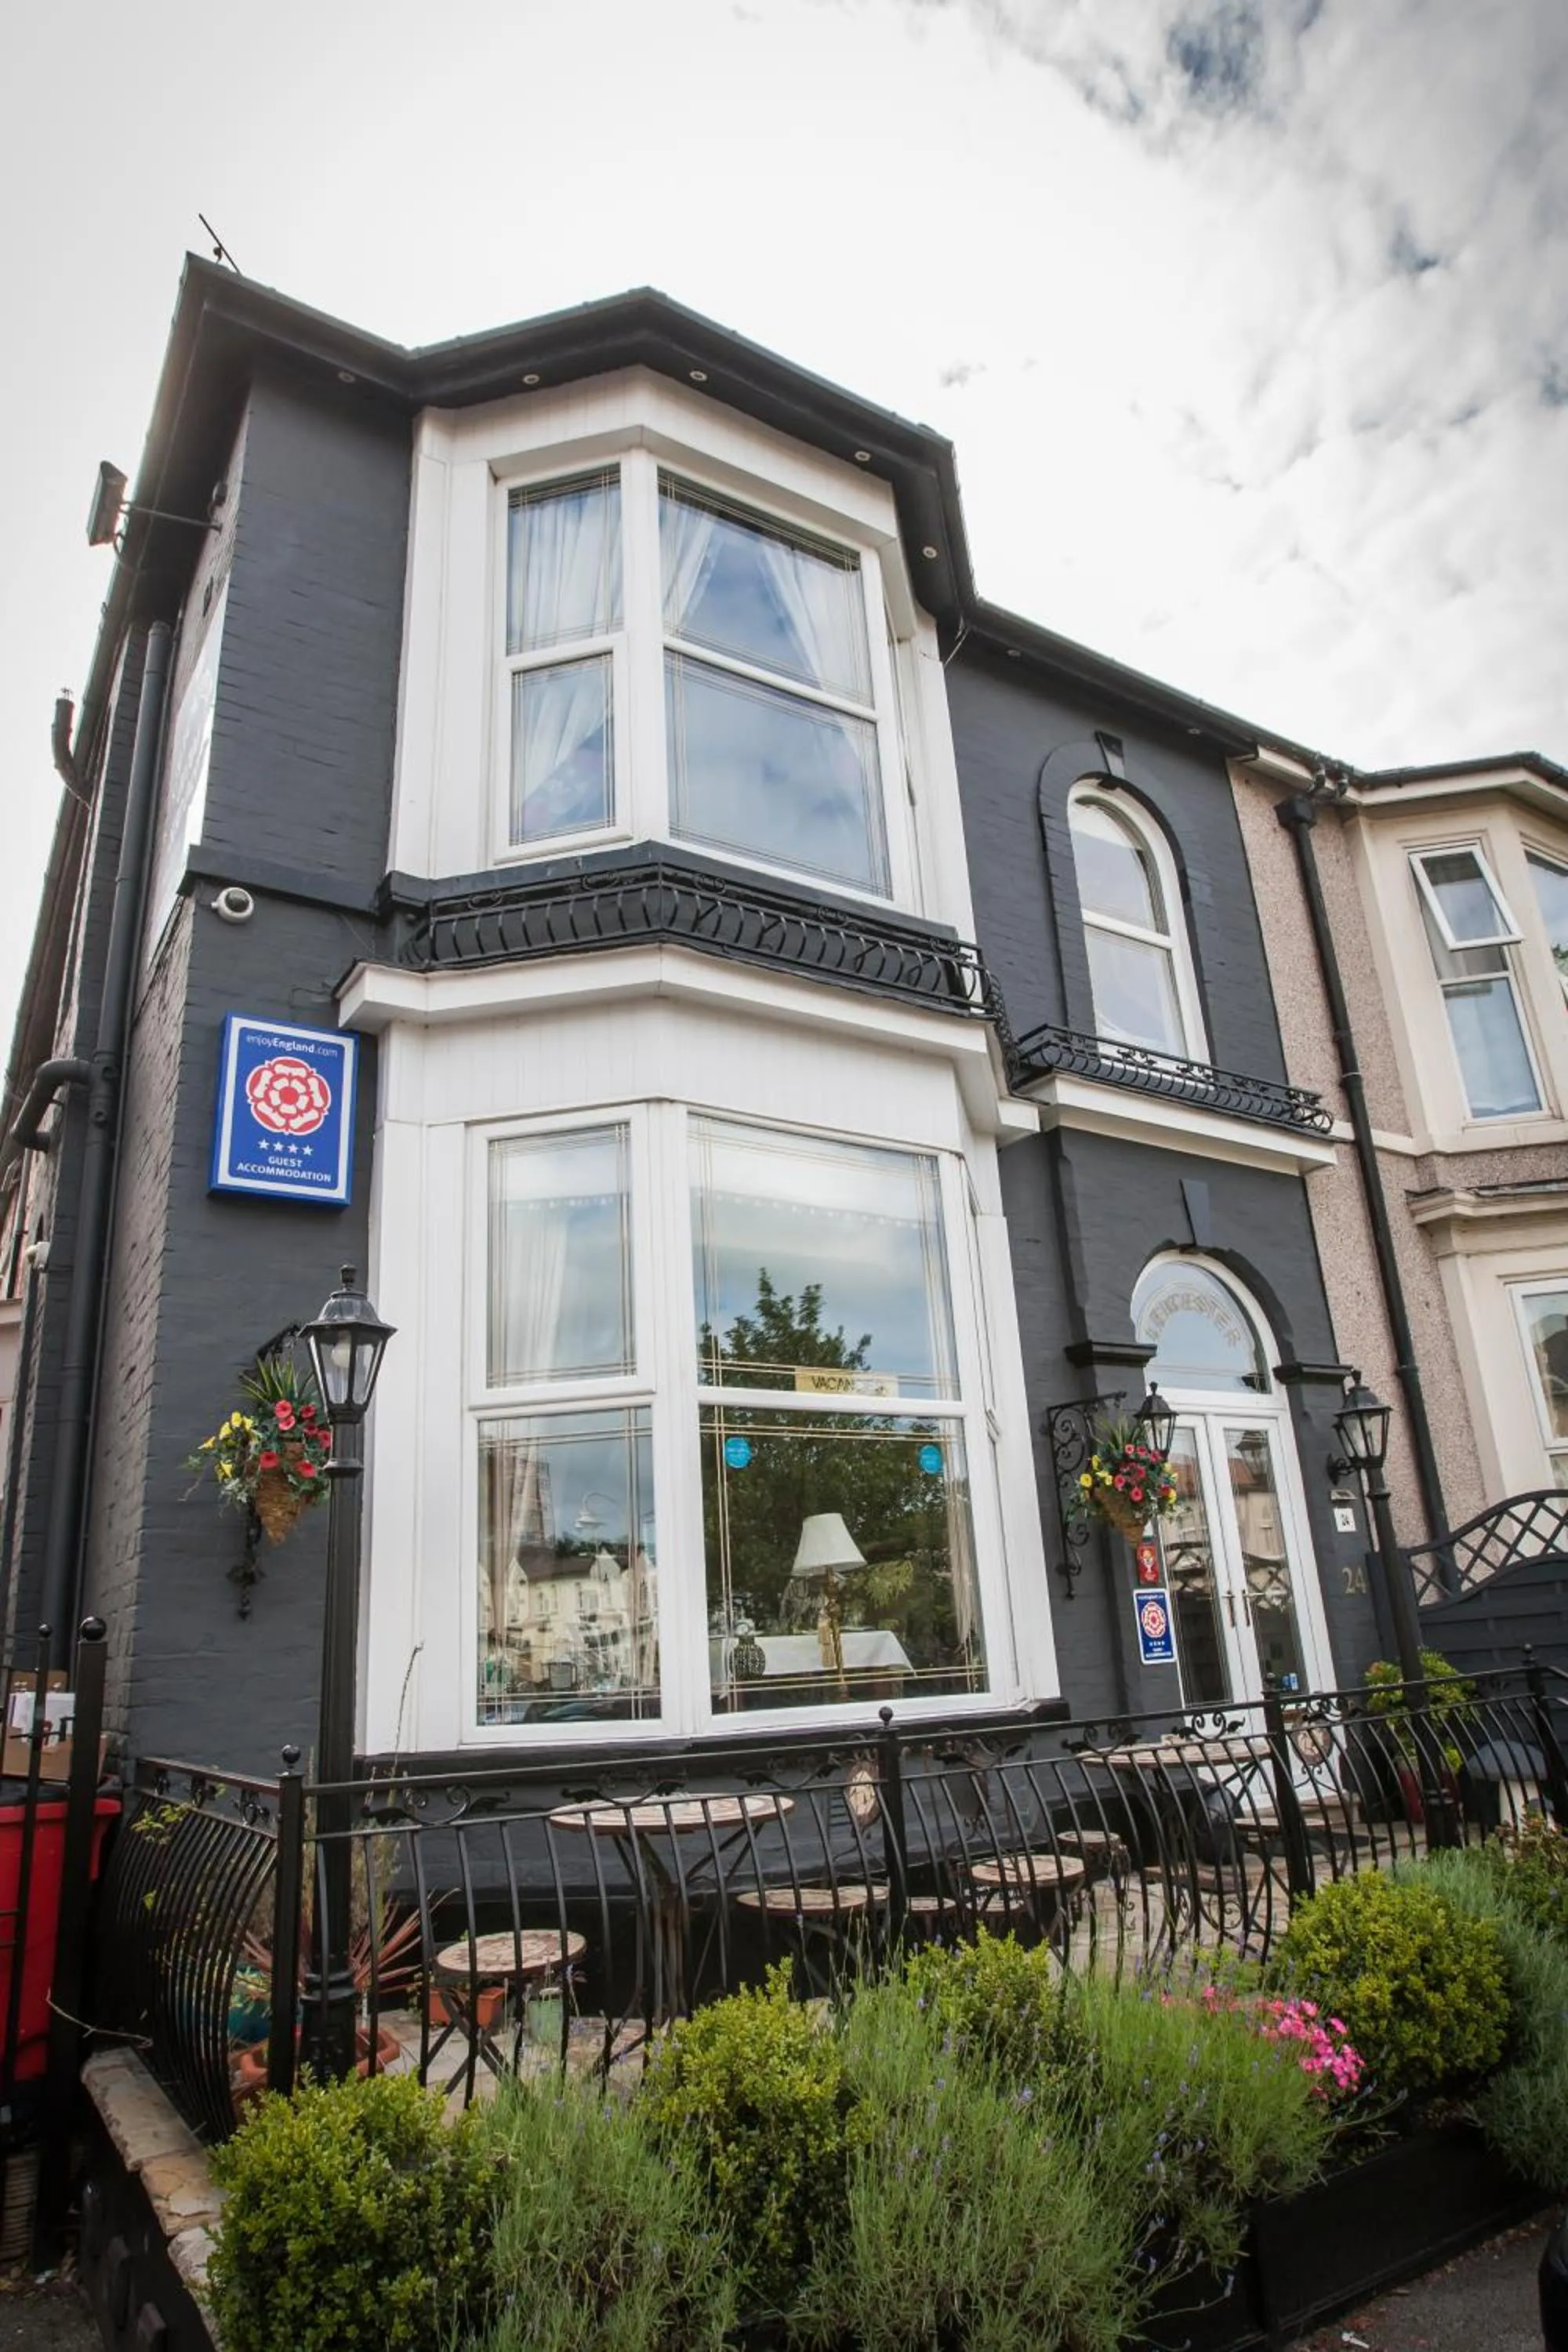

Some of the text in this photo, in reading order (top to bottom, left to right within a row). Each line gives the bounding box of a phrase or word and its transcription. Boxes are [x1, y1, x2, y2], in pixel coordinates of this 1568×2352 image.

[245, 1034, 338, 1057] enjoyEngland.com
[237, 1162, 332, 1182] ACCOMMODATION
[268, 1156, 303, 1167] GUEST
[1341, 1567, 1367, 1594] 24
